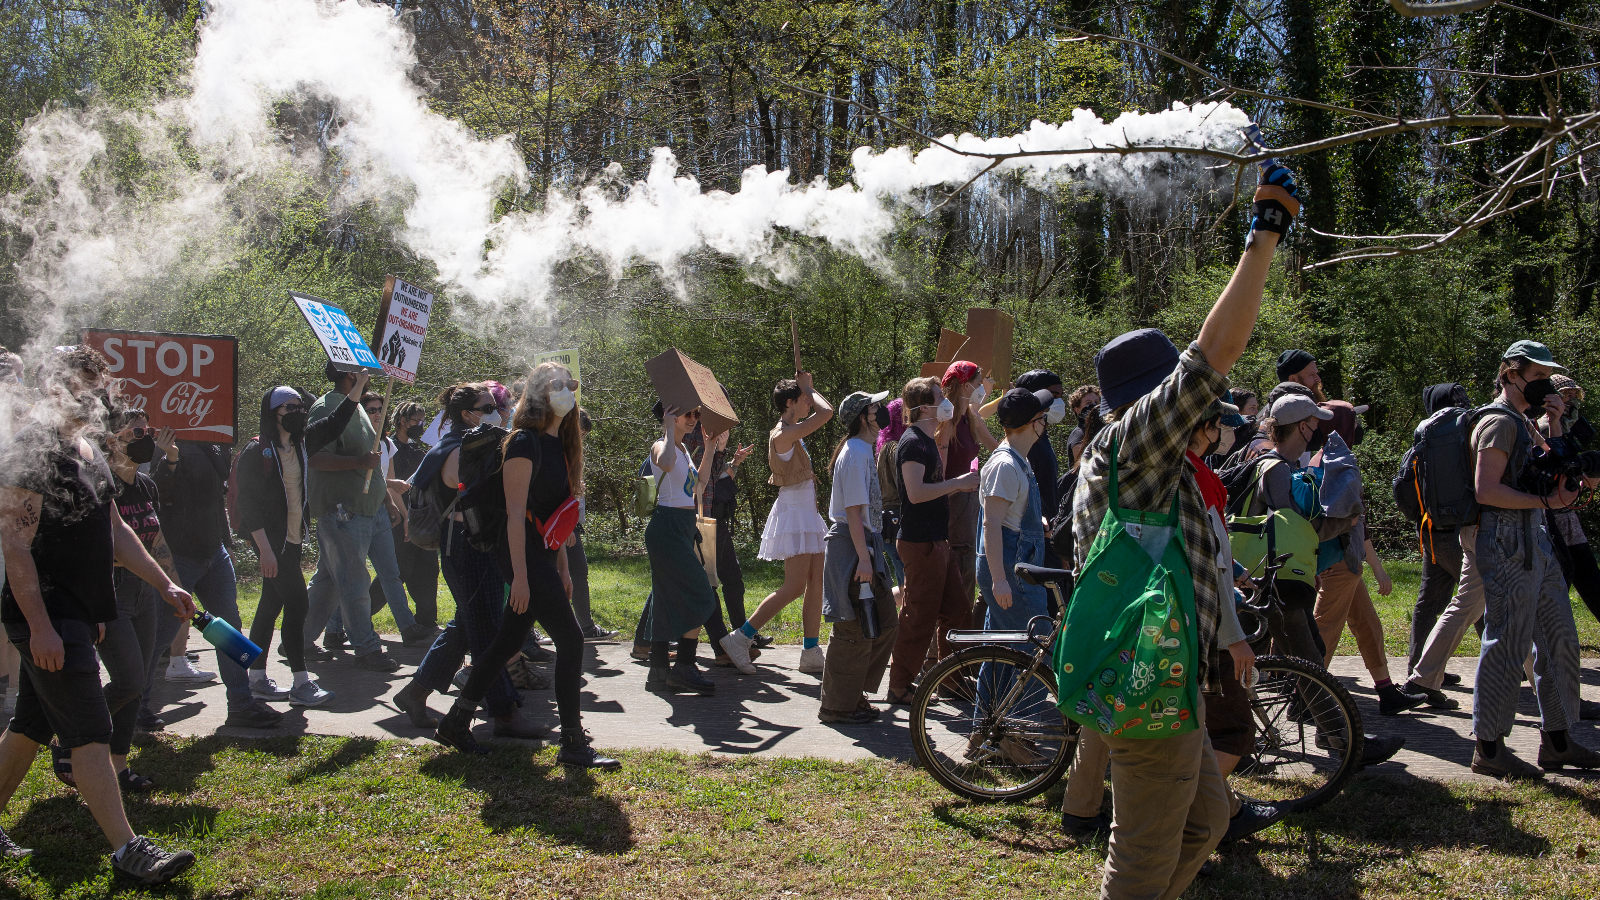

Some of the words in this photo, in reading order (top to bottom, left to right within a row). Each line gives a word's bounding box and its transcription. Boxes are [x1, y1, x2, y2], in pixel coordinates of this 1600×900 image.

[400, 282, 408, 292] WE
[408, 286, 418, 296] ARE
[418, 290, 428, 300] NOT
[394, 292, 428, 315] OUTNUMBERED,
[329, 311, 352, 328] STOP
[401, 307, 408, 317] WE
[408, 310, 418, 321] ARE
[388, 314, 426, 335] OUT-ORGANIZED!
[344, 330, 362, 345] COP
[103, 338, 215, 377] STOP
[355, 348, 375, 364] CITY
[161, 382, 220, 427] City
[119, 503, 144, 515] WILL
[143, 516, 160, 528] AB
